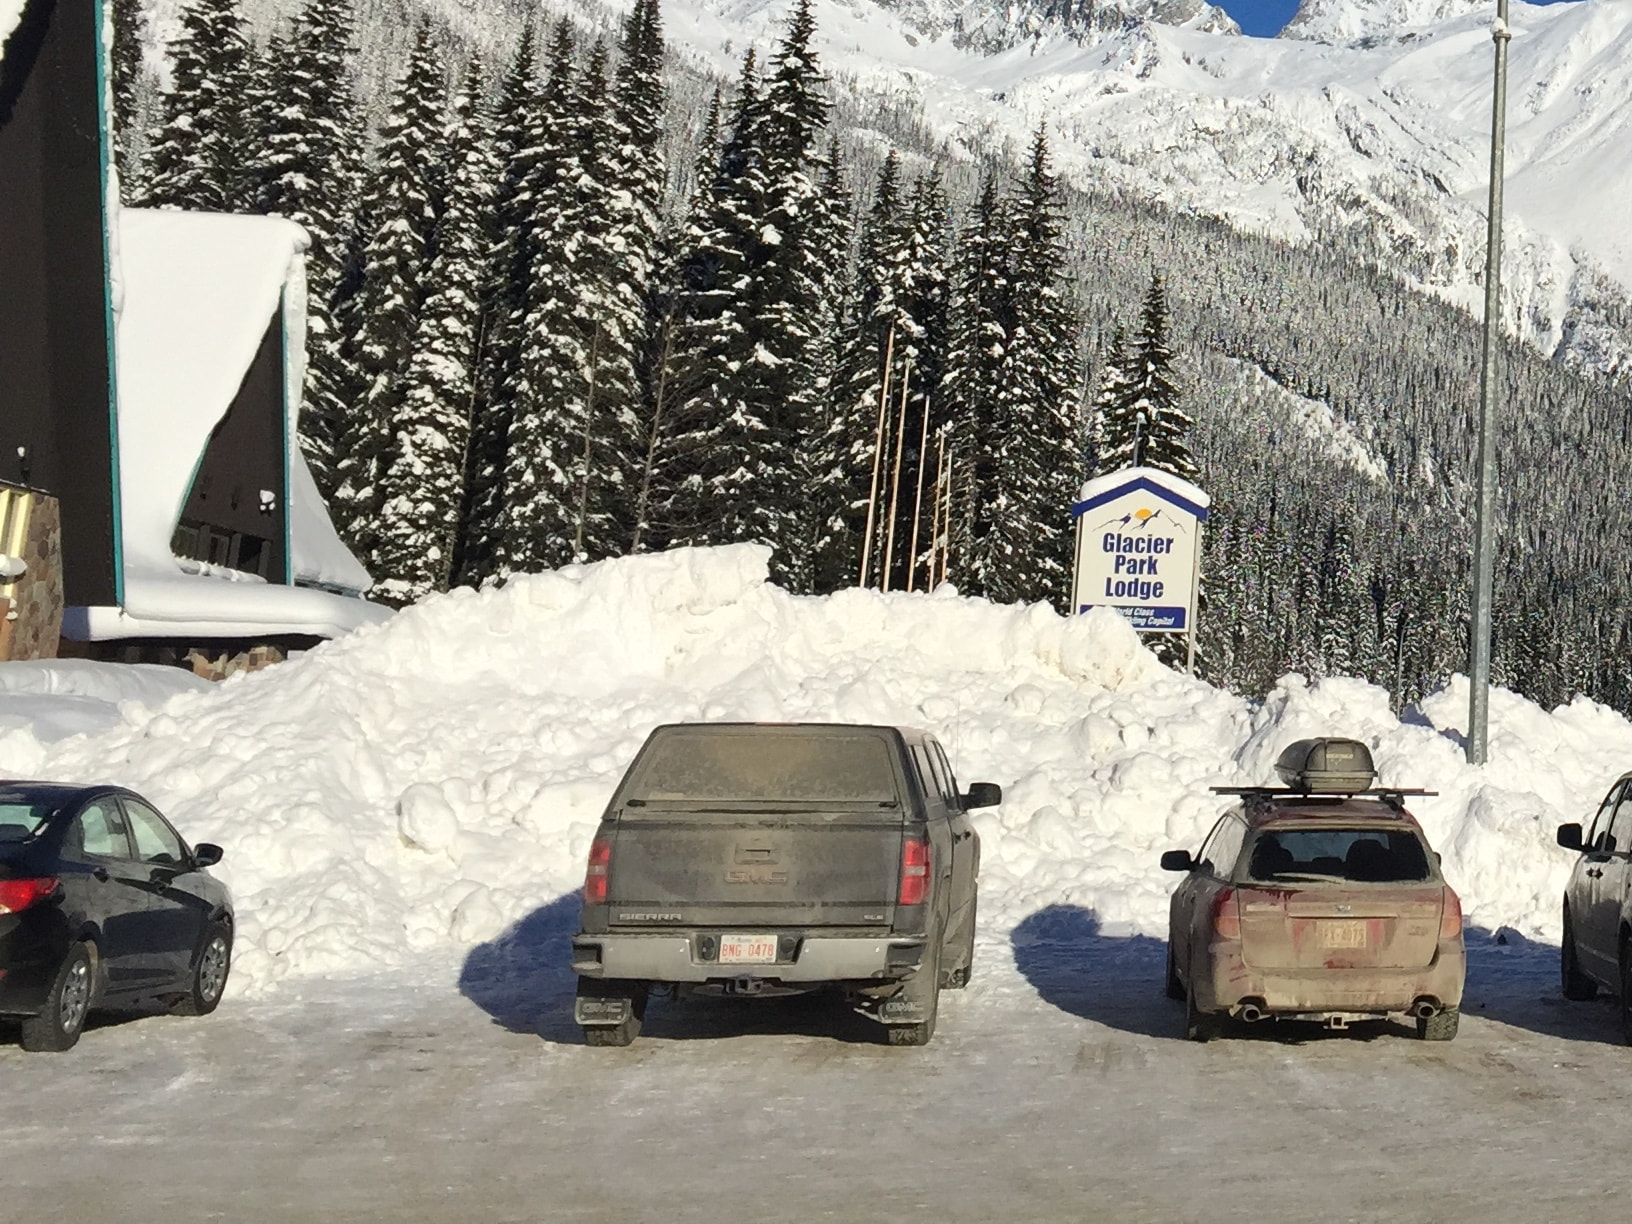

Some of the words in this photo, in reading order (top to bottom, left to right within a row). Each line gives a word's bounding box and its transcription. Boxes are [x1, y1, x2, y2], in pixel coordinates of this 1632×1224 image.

[1103, 533, 1174, 554] Glacier
[1114, 555, 1158, 575] Park
[1105, 577, 1164, 600] Lodge
[618, 912, 683, 921] SIERRA
